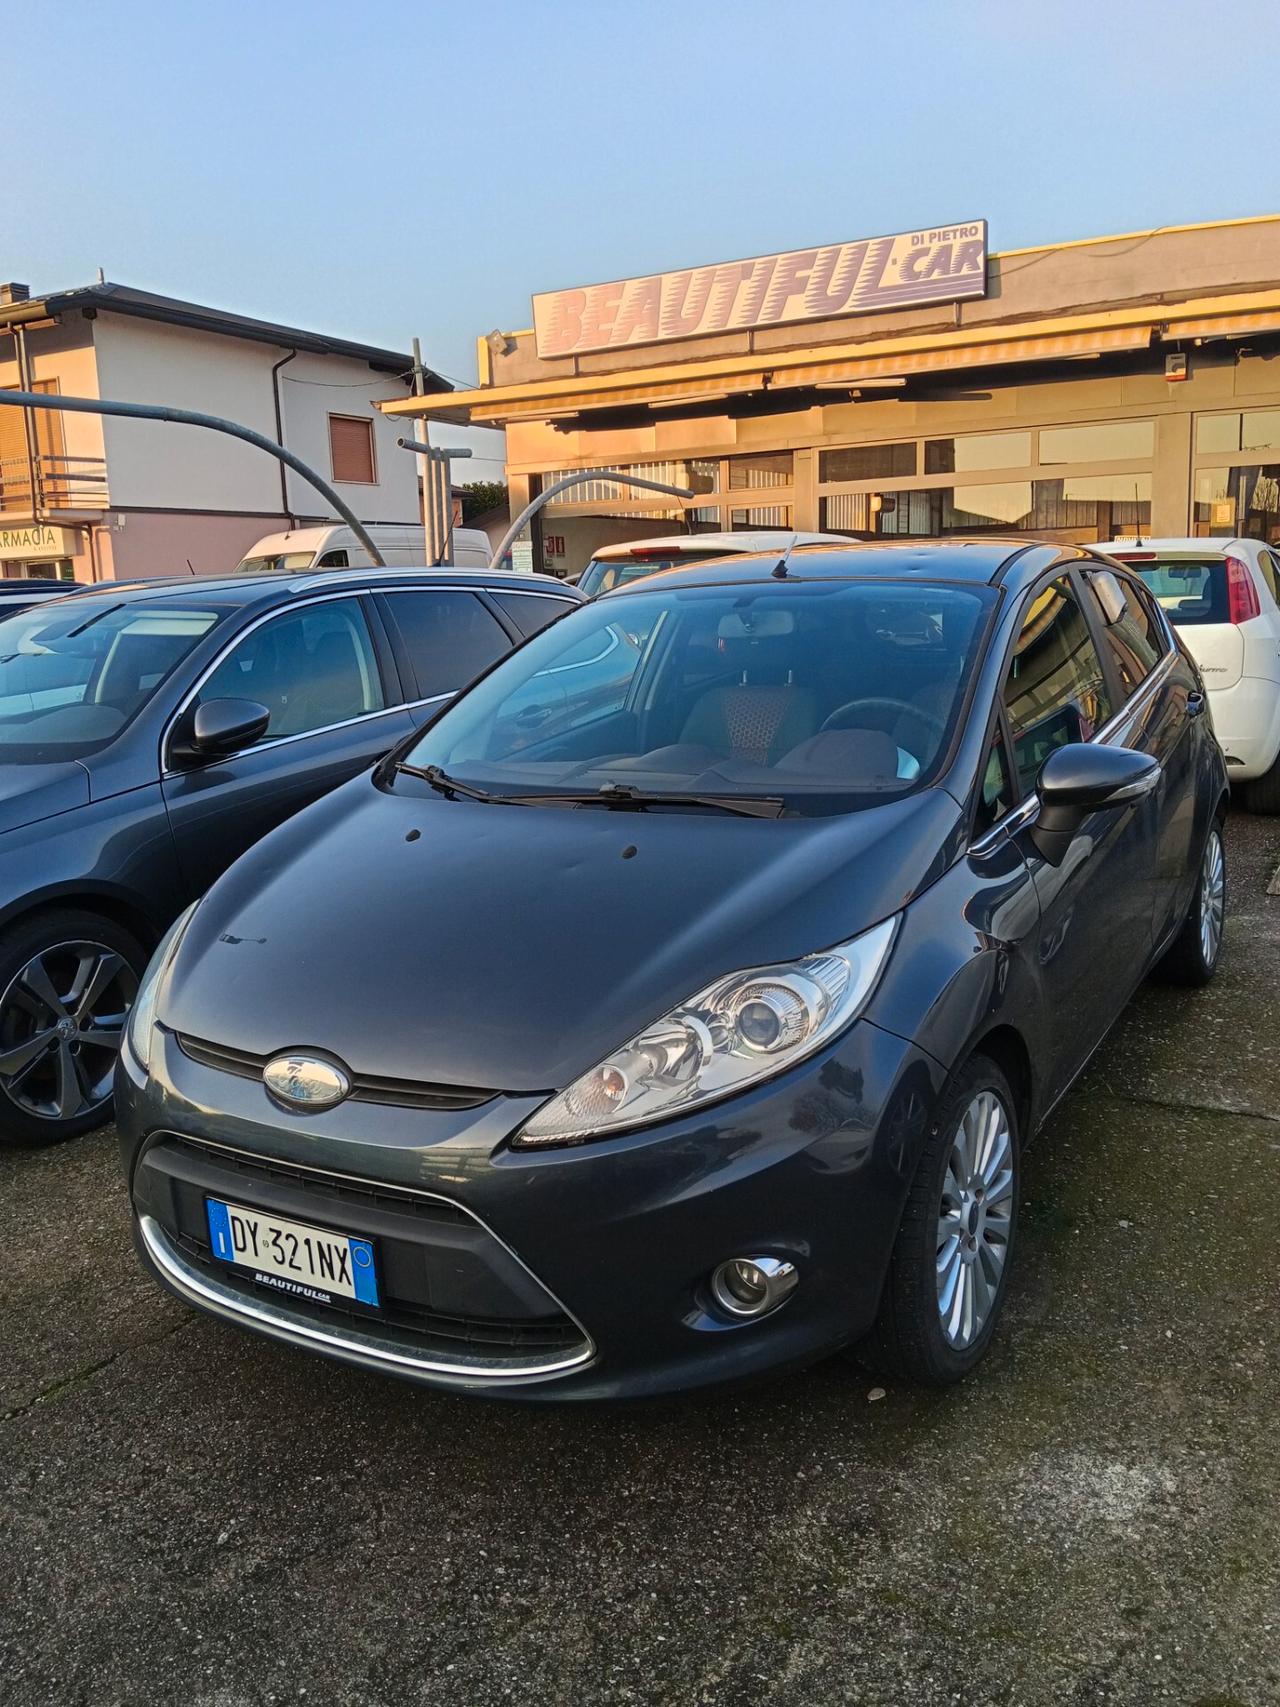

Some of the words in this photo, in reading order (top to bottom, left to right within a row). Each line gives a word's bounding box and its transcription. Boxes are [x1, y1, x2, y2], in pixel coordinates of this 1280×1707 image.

[911, 234, 925, 246] DI
[928, 225, 979, 243] PIETRO
[539, 237, 897, 352] BEAUTIFUL
[898, 239, 984, 281] CAR
[230, 1215, 259, 1257] DY
[268, 1227, 352, 1286] 321NX
[255, 1273, 319, 1299] BEAUTIFUL
